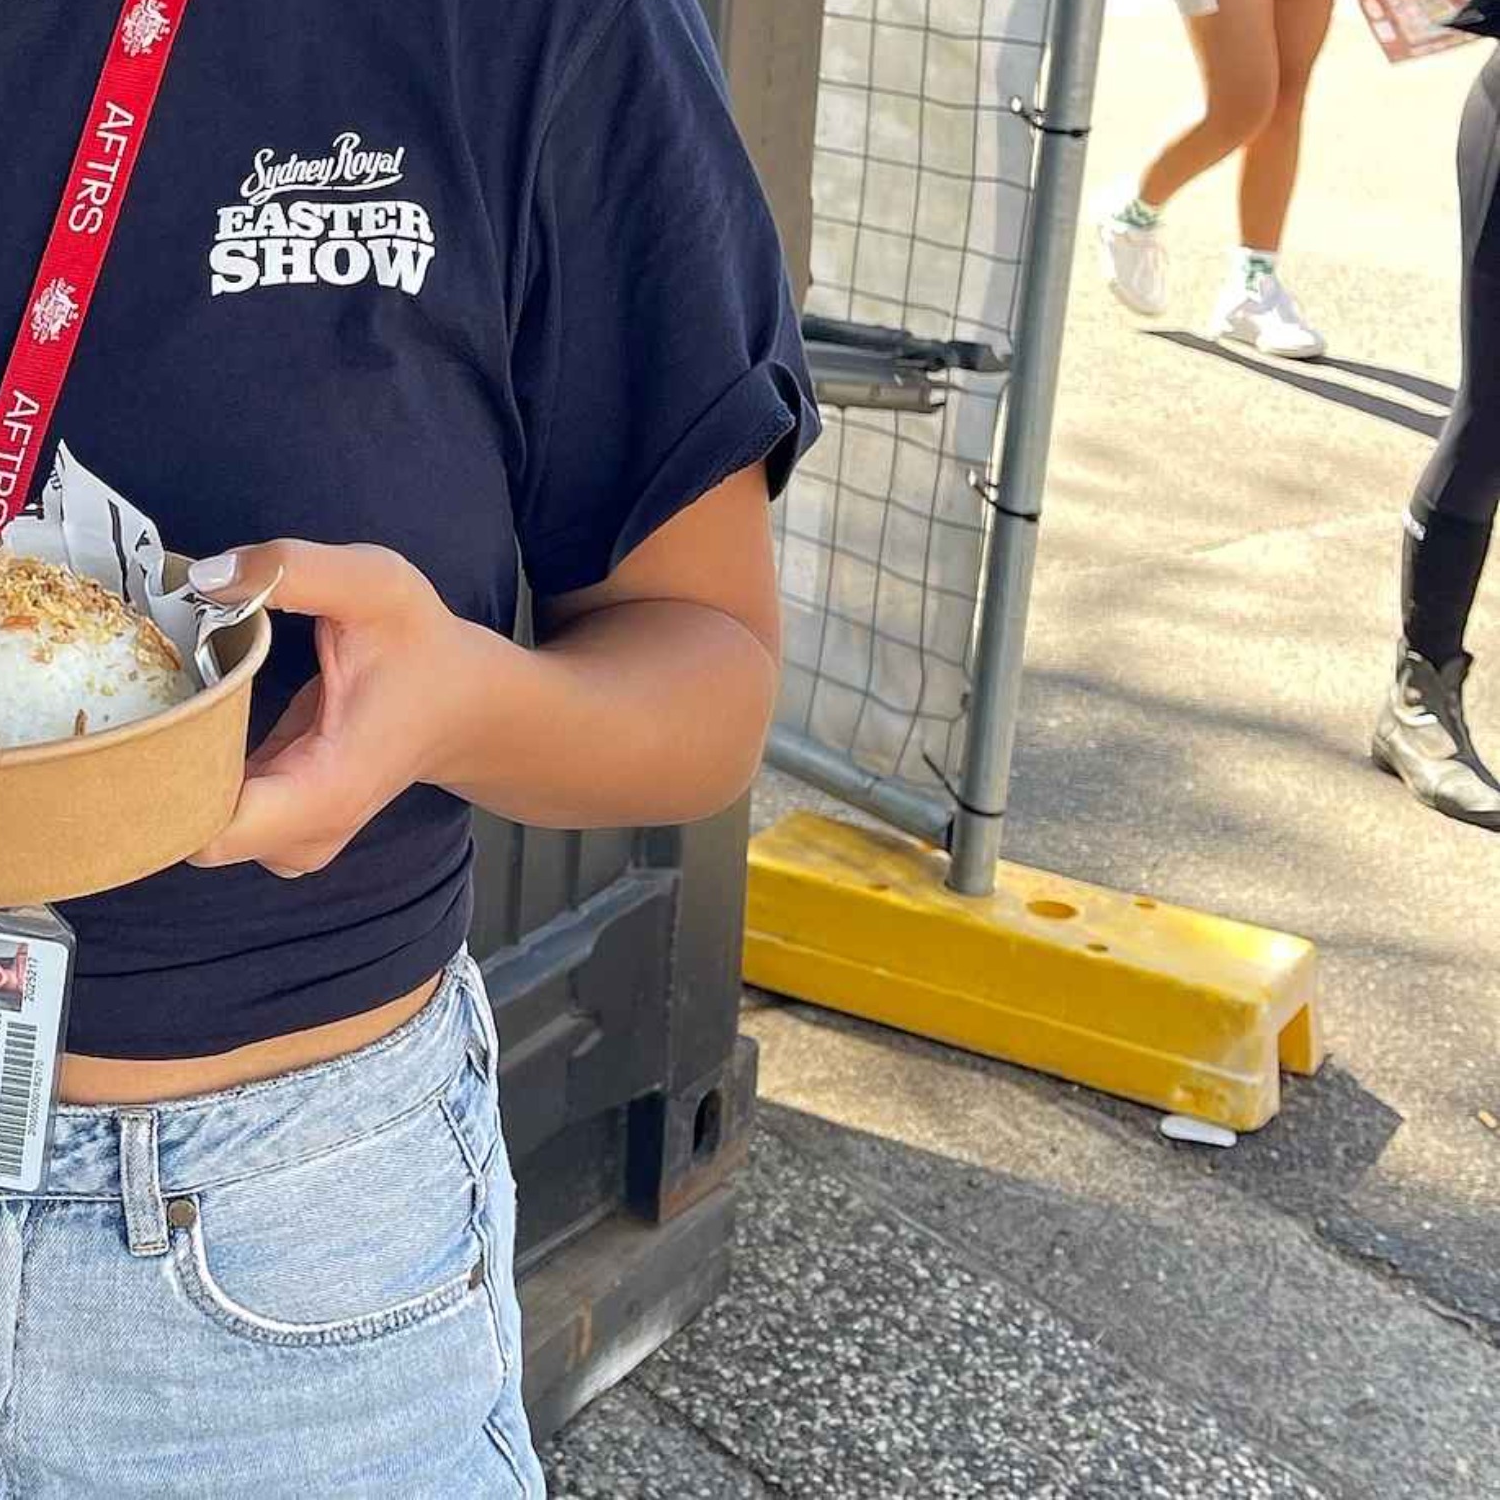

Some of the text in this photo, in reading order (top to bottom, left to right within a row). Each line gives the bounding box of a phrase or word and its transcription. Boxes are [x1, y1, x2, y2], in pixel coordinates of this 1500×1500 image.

[67, 100, 135, 236] AFTRS
[240, 131, 405, 205] Sydney Royal
[214, 200, 435, 242] EASTER
[209, 238, 435, 297] SHOW
